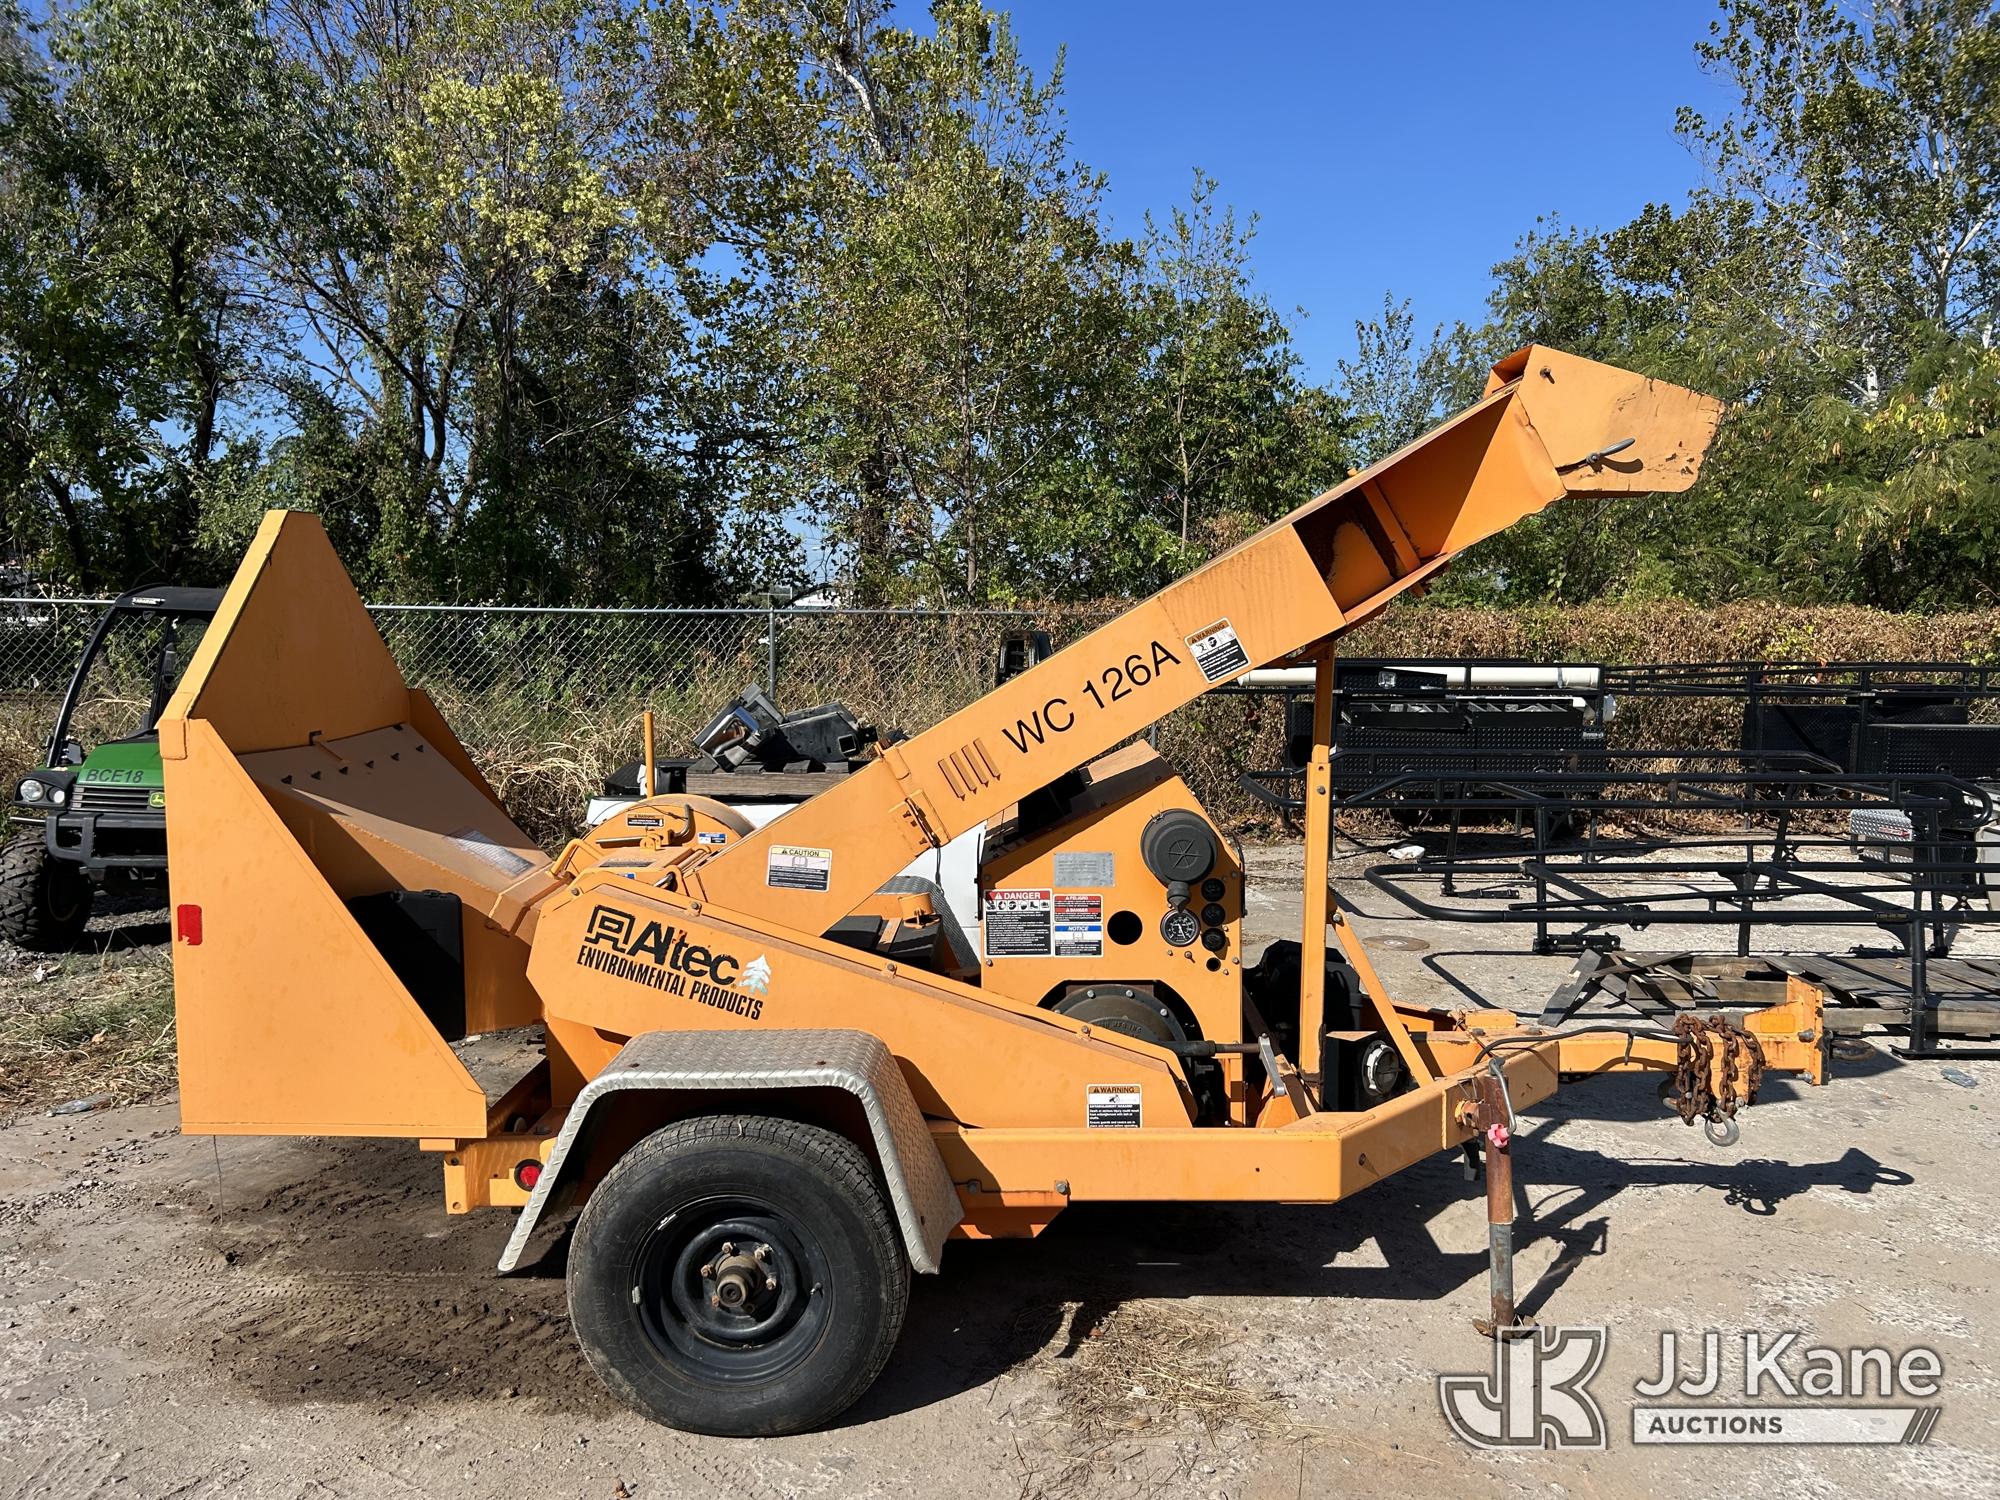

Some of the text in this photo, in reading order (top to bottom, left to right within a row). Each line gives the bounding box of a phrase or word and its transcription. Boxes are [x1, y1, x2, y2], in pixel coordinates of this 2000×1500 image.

[1196, 623, 1226, 642] WARNING
[1001, 698, 1075, 754] WC
[1082, 640, 1181, 709] 126A
[86, 769, 144, 783] BCE18
[789, 849, 820, 857] CAUTION
[1004, 892, 1041, 900] DANGER
[627, 920, 740, 986] Altec
[577, 945, 764, 1021] ENVIRONMENTAL PRODUCTS
